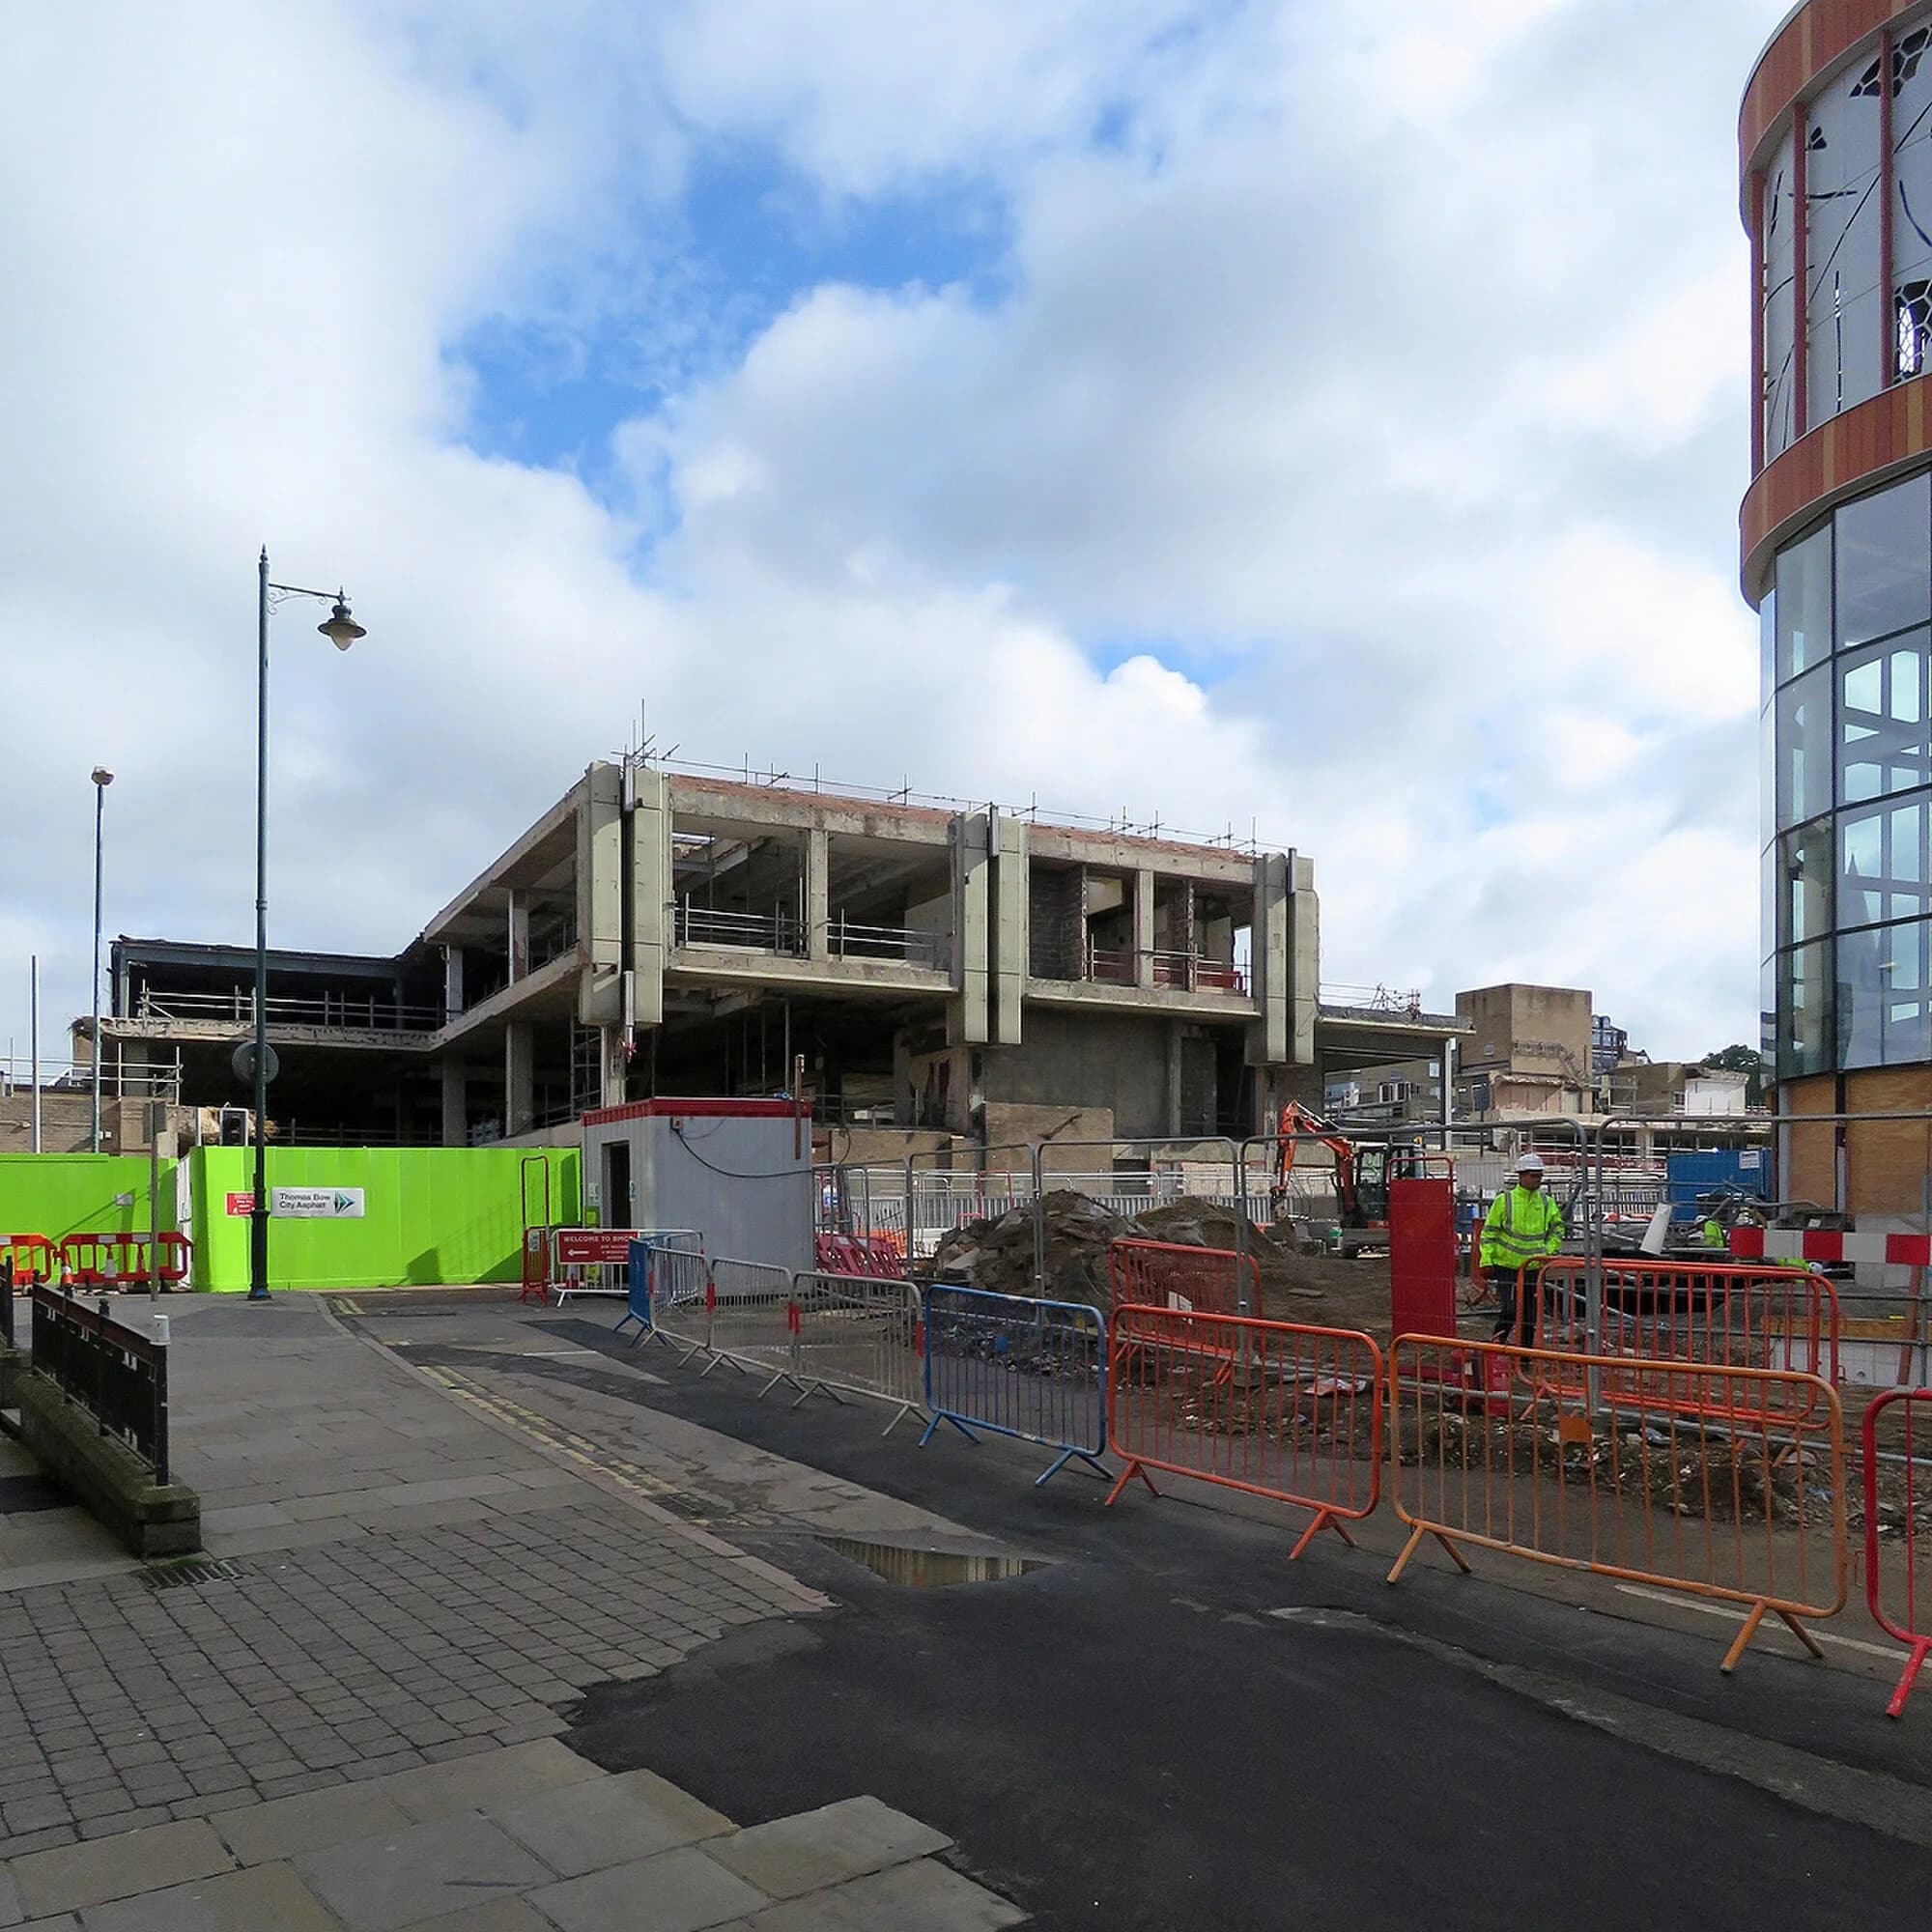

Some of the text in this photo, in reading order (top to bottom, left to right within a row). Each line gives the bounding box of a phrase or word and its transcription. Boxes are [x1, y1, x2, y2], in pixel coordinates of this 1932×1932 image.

[279, 1192, 311, 1201] Thomas
[279, 1201, 326, 1209] City Asphalt
